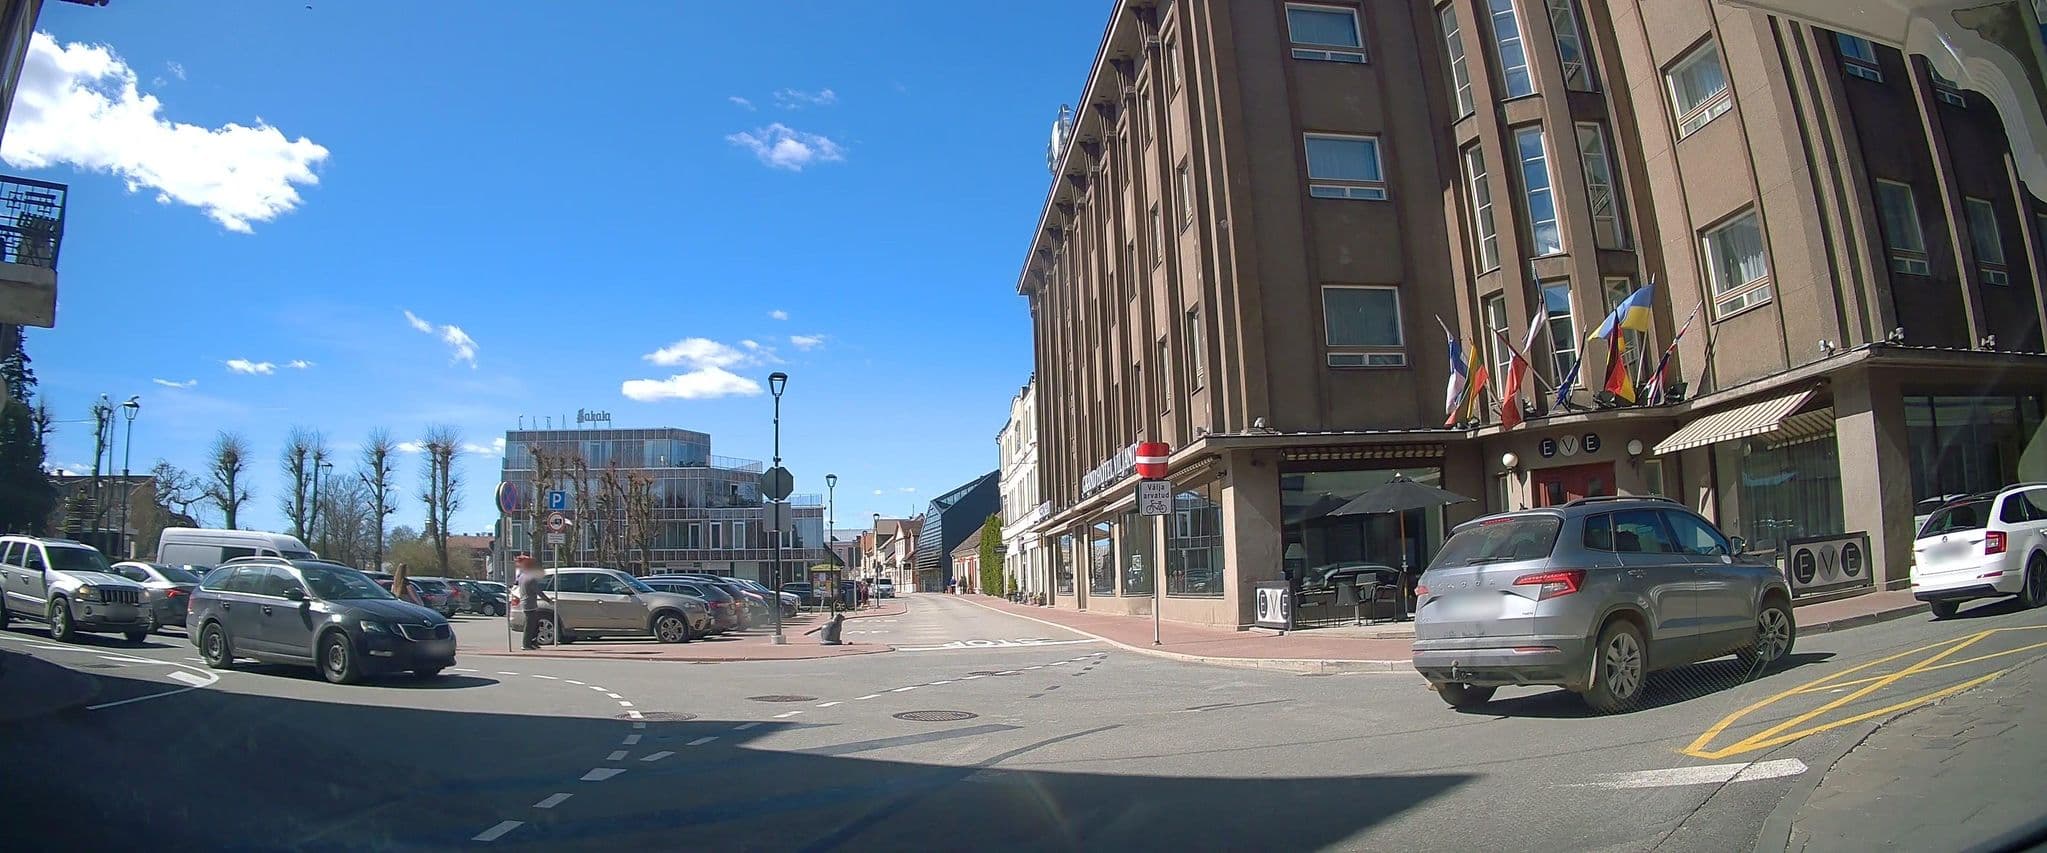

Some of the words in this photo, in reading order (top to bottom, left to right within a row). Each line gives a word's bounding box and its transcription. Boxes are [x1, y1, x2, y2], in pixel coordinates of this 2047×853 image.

[1542, 434, 1597, 456] EVE
[1147, 483, 1165, 492] Välja
[552, 493, 562, 508] P
[1798, 546, 1858, 579] EVE
[1260, 592, 1289, 616] EVE
